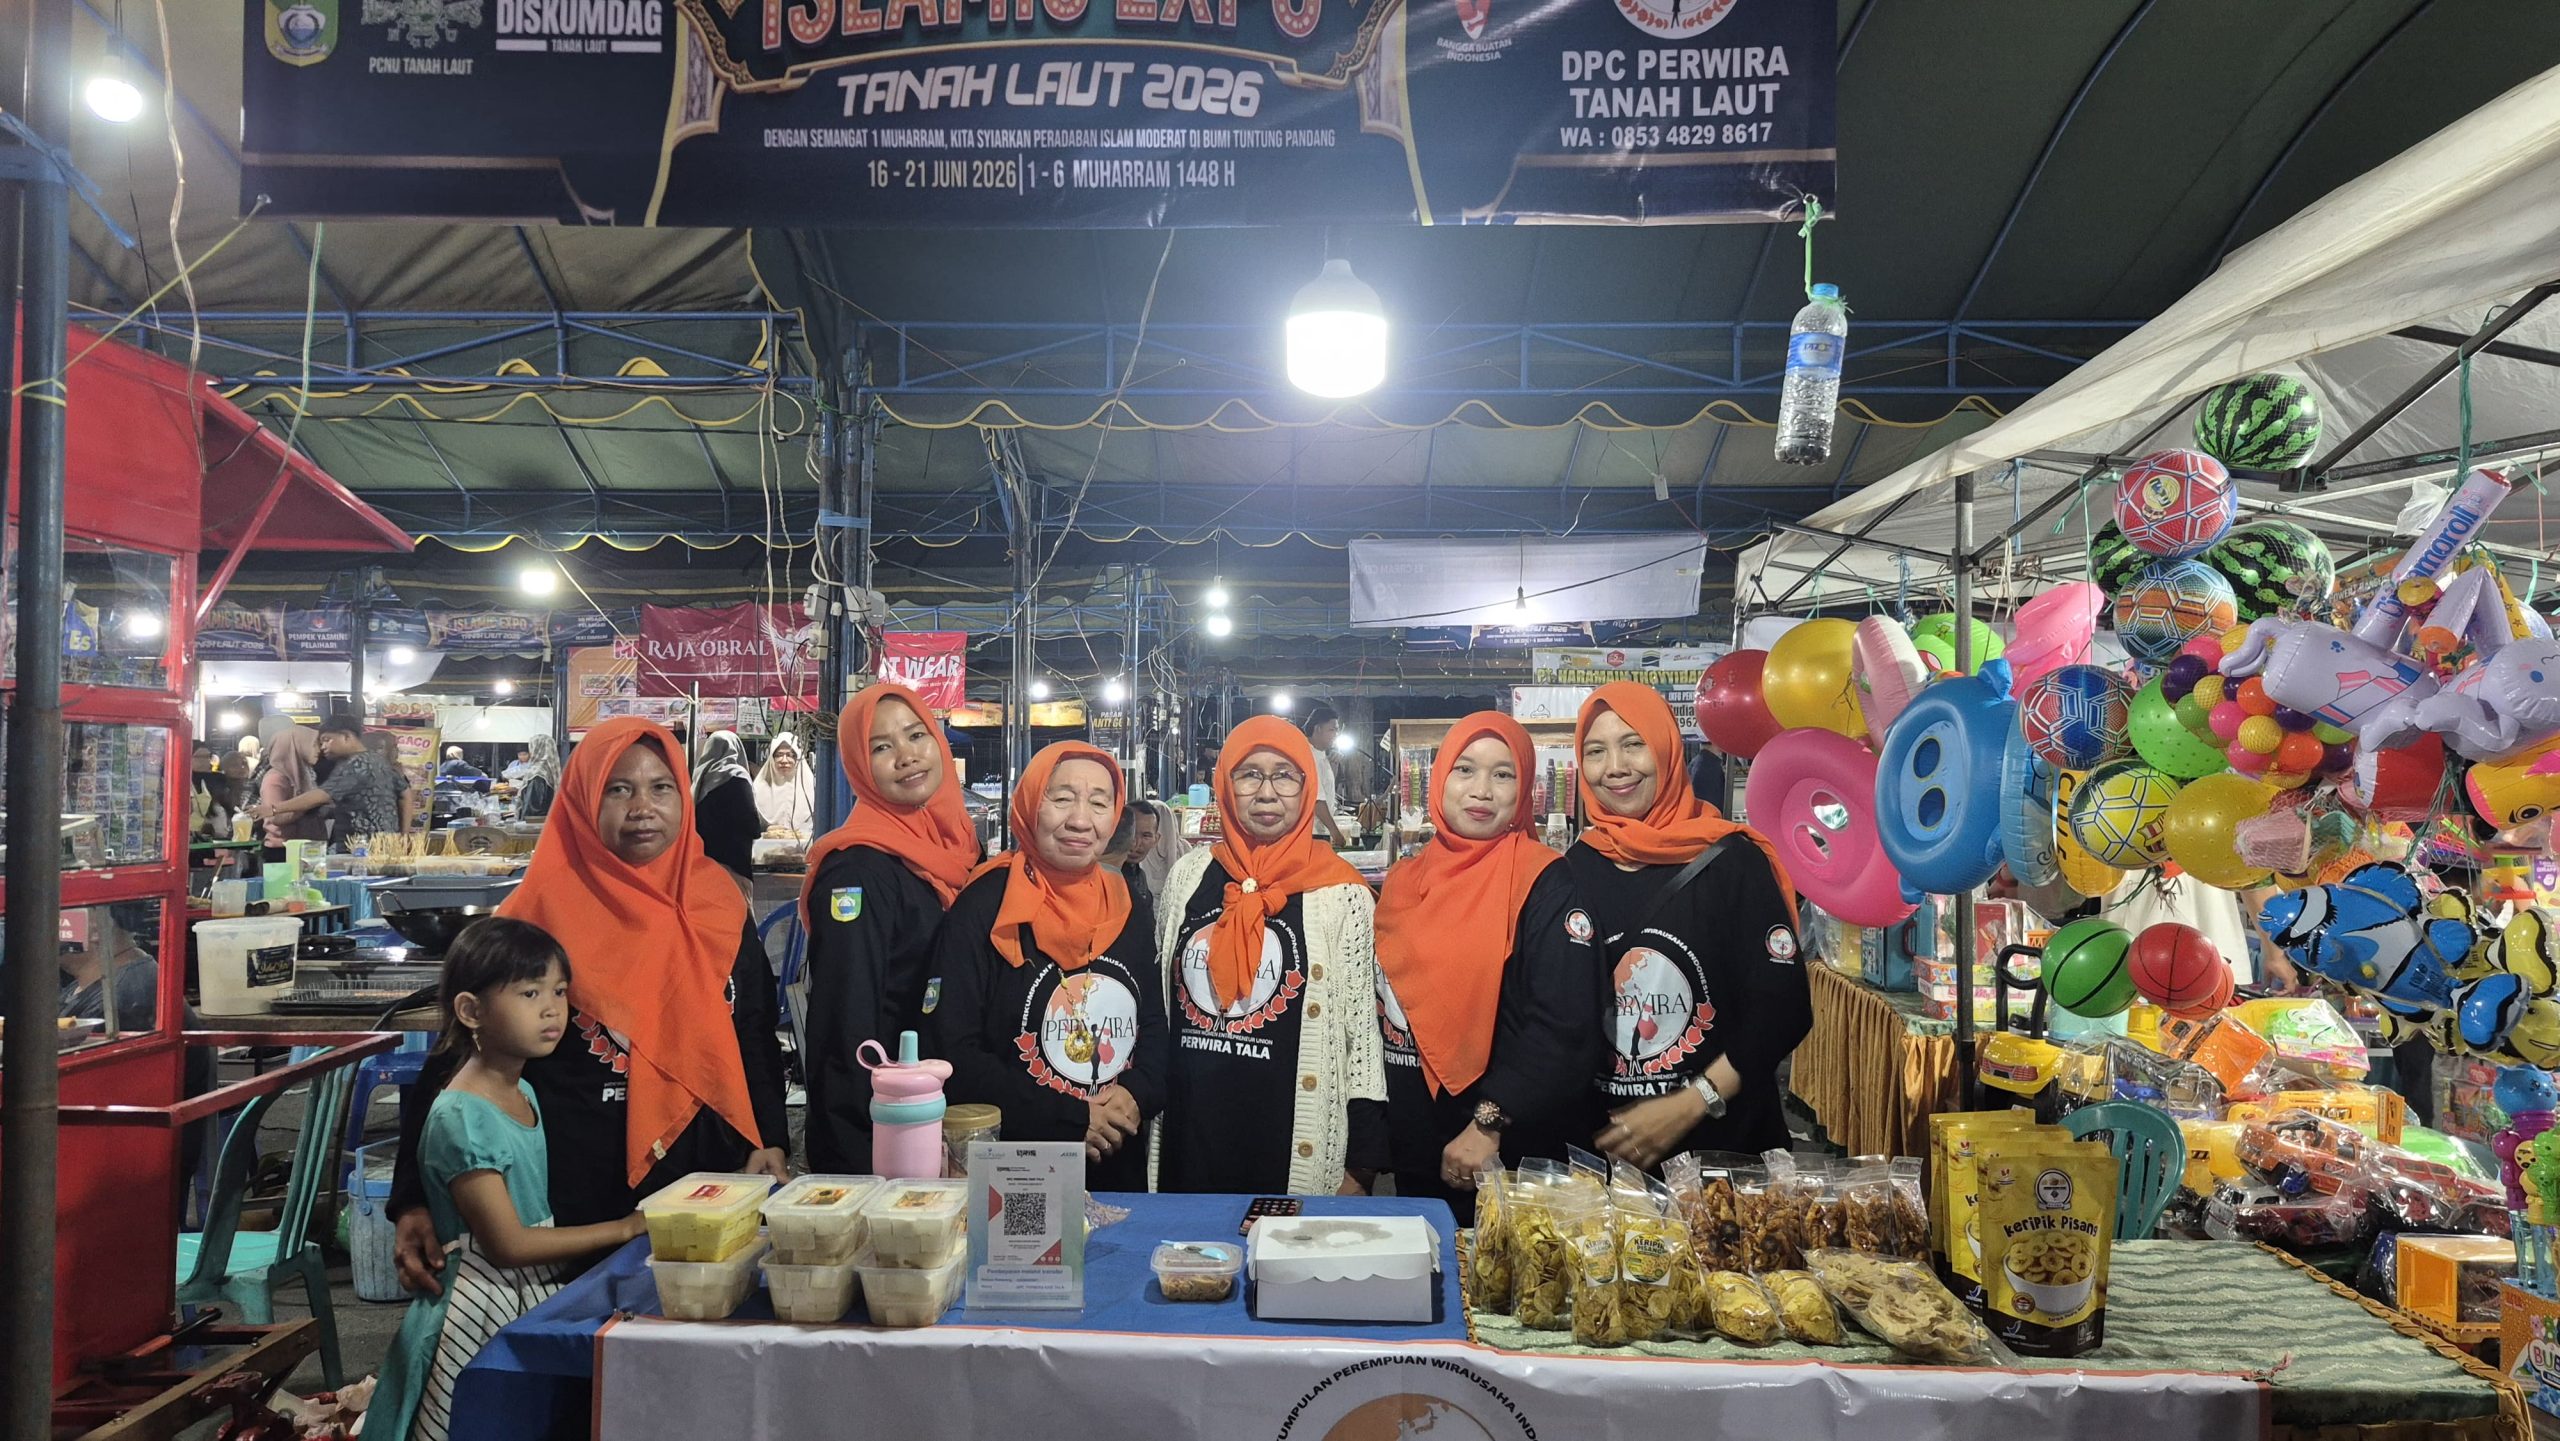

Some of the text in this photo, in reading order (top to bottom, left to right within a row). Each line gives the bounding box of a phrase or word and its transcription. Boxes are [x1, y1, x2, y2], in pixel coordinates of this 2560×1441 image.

[497, 0, 662, 35] DISKUMDAG
[552, 39, 608, 53] TANAH LAUT
[1437, 37, 1512, 53] BANGGA BUATAN
[1446, 50, 1502, 62] INDONESIA
[369, 57, 474, 75] PCNU TANAH LAUT
[1562, 46, 1790, 81] DPC PERWIRA
[837, 61, 1265, 118] TANAH LAUT 2026
[1569, 82, 1780, 119] TANAH LAUT
[763, 128, 1336, 150] DENGAN SEMANGAT 1 MUHARRAM, KITA SYIARKAN PERADABAN ISLAM MODERAT DI BUMI TUNTUNG PANDANG
[1561, 126, 1592, 148] WA
[1611, 125, 1660, 147] 0853
[1666, 123, 1716, 146] 4829
[1722, 121, 1773, 145] 8617
[867, 159, 888, 188] 16
[905, 159, 926, 188] 21
[931, 159, 967, 188] JUNI
[973, 159, 1017, 188] 2026
[1053, 160, 1065, 188] 6
[1072, 160, 1170, 188] MUHARRAM
[1176, 160, 1219, 187] 1448
[1224, 160, 1235, 187] H
[288, 633, 316, 641] PEMPEK
[300, 641, 337, 650] PELAIHARI
[648, 638, 770, 661] RAJA OBRAL
[904, 655, 960, 680] WEAR
[1180, 1035, 1271, 1060] PERWIRA TALA
[1333, 1355, 1427, 1382] PEREMPUAN
[1431, 1357, 1515, 1414] WIRAUSAHA
[1514, 1412, 1538, 1441] IND
